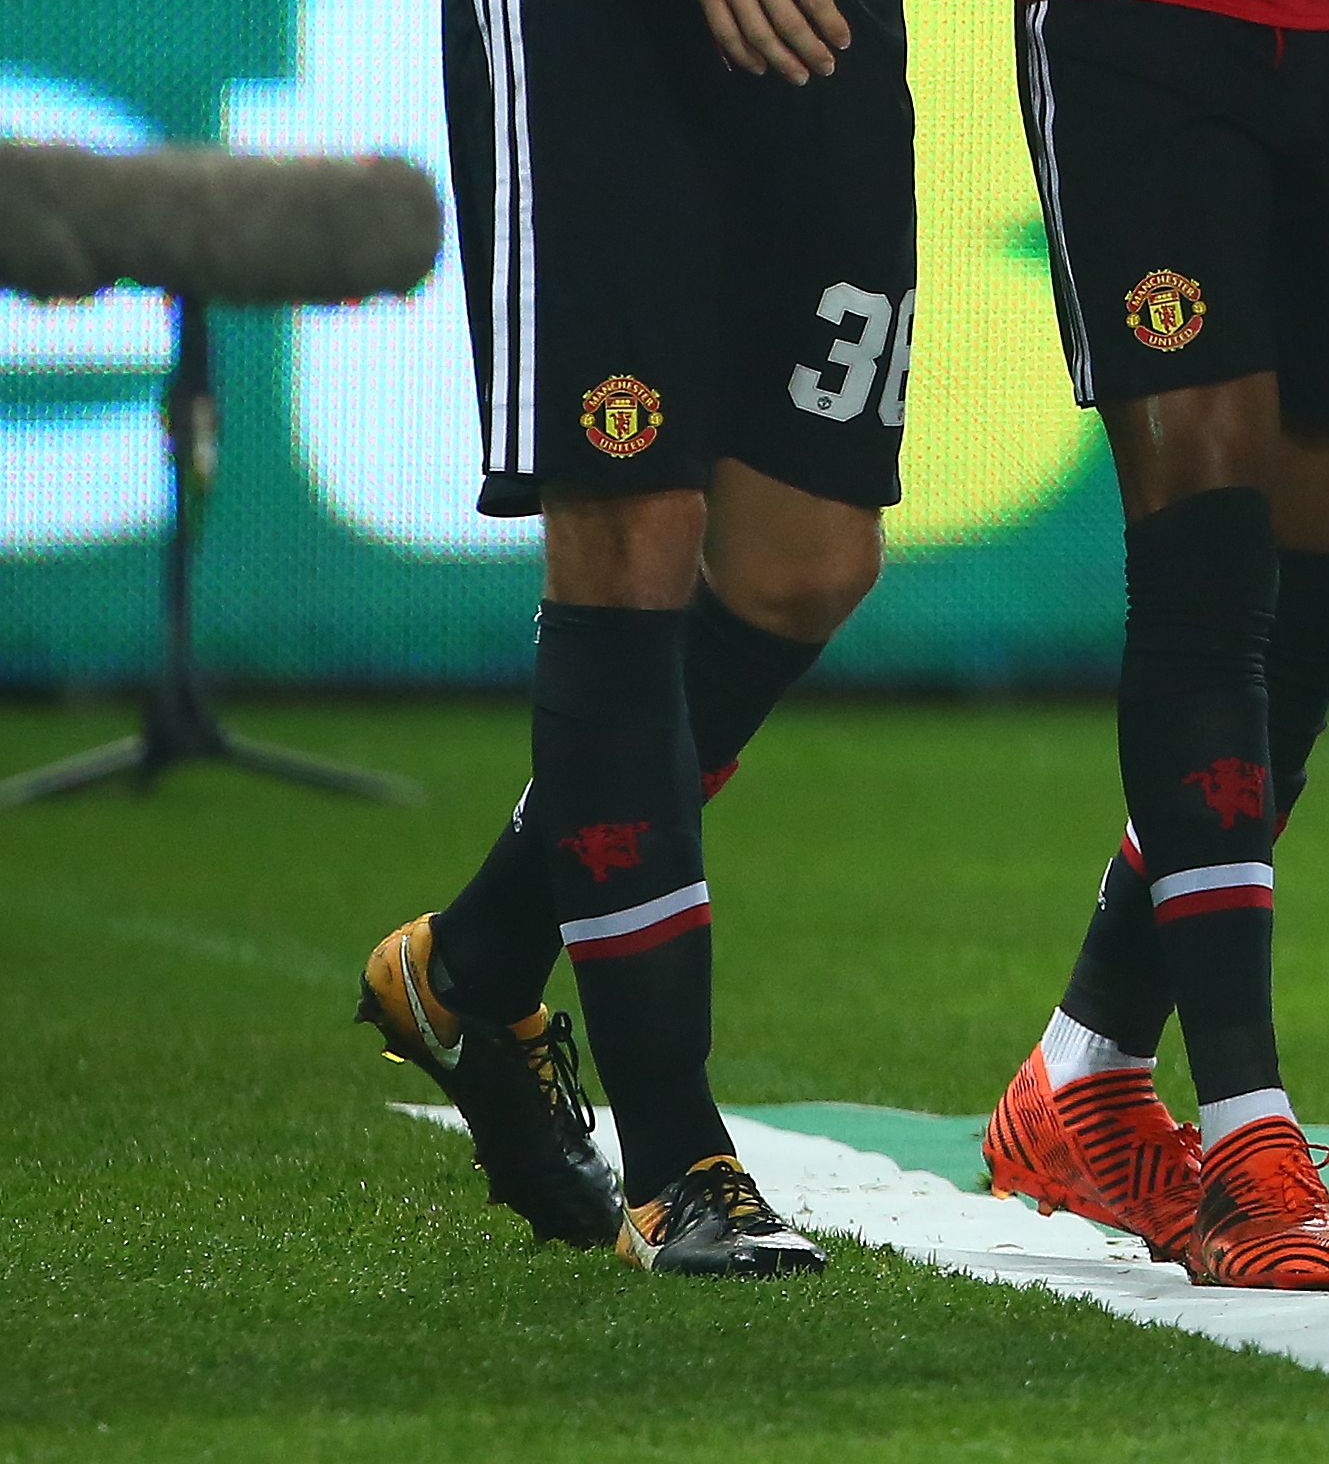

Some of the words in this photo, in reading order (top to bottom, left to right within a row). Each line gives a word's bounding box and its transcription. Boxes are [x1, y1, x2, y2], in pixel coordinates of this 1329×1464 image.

[1131, 275, 1195, 307] MANCHESTER
[1148, 328, 1193, 346] UNITED
[588, 381, 654, 407] MANCHESTER
[600, 438, 645, 452] UNITED
